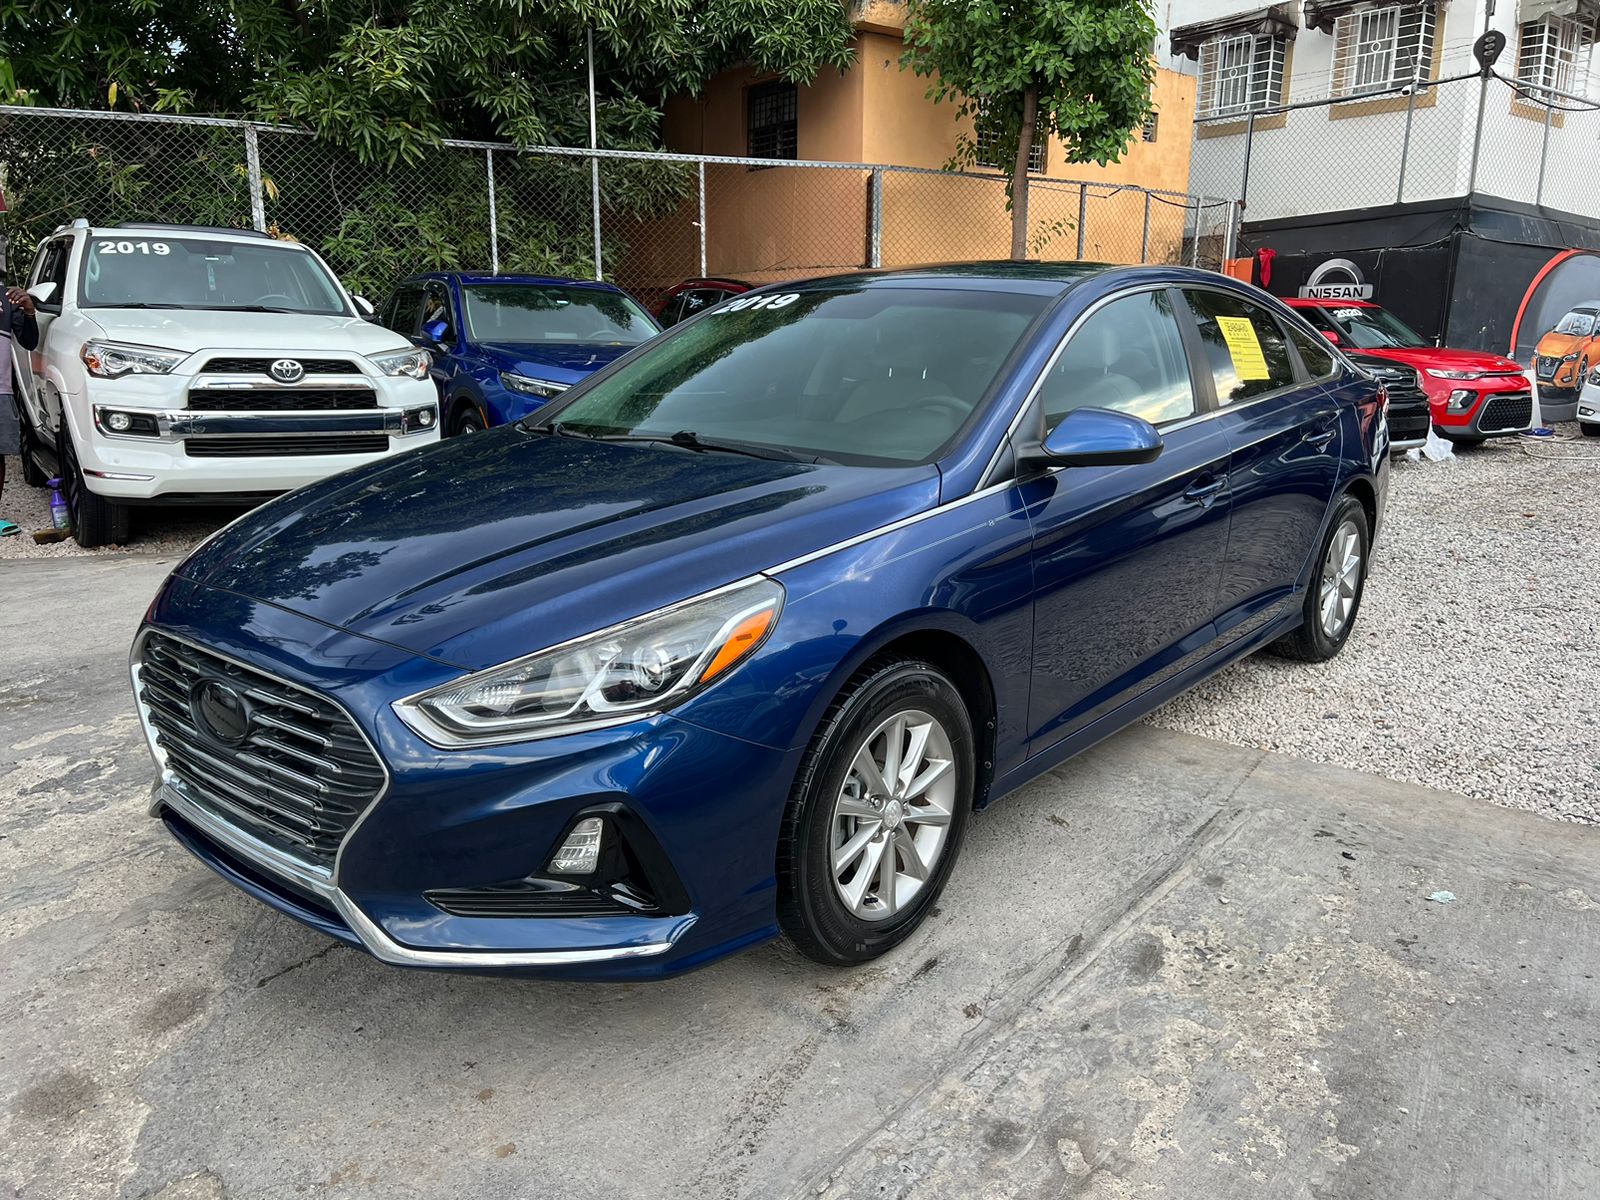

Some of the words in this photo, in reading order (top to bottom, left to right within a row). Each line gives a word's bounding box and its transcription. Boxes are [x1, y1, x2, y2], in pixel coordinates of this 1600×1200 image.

[98, 241, 171, 255] 2019
[1308, 286, 1364, 299] NISSAN
[710, 293, 801, 315] 2019
[1333, 308, 1363, 318] 2020
